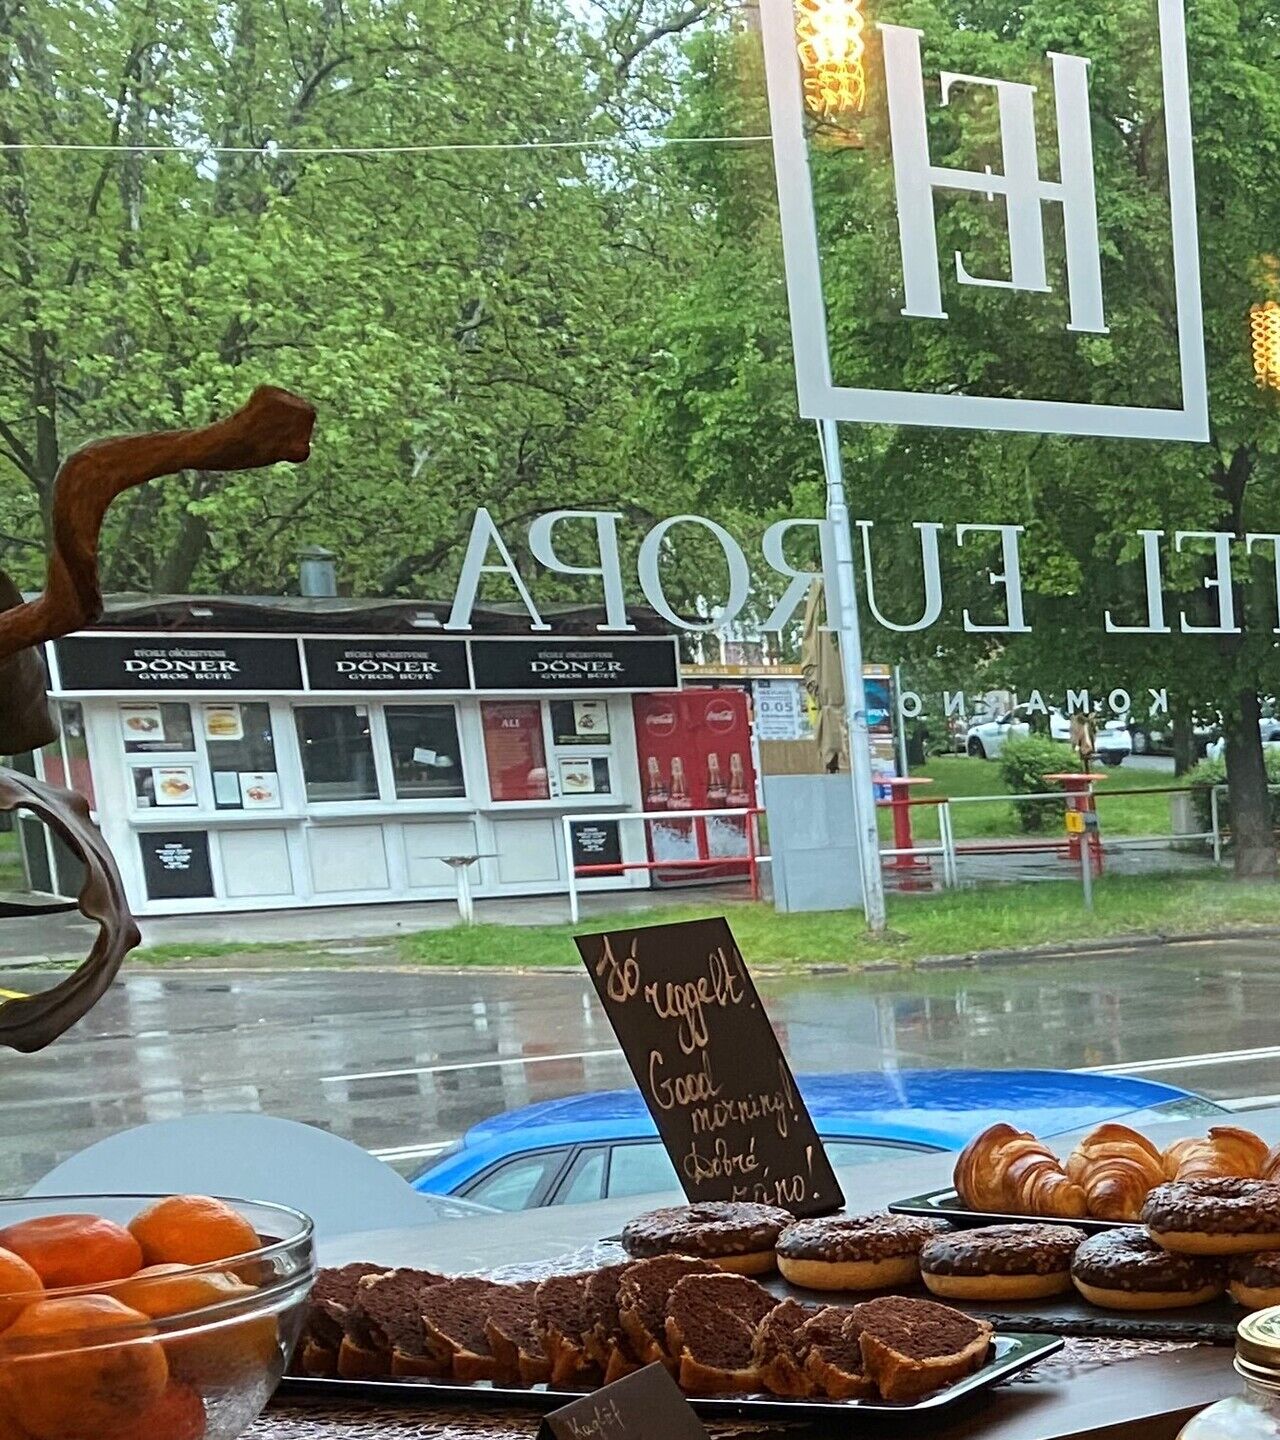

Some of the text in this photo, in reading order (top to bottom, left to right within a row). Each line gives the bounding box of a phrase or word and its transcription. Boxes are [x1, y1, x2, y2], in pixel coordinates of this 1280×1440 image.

[123, 658, 240, 672] DÖNER
[335, 659, 441, 673] DÖNER
[530, 659, 625, 672] DÖNER
[596, 935, 641, 1002] Jó
[650, 1050, 721, 1110] Good
[691, 1058, 799, 1138] morning!
[684, 1136, 758, 1185] Dobré
